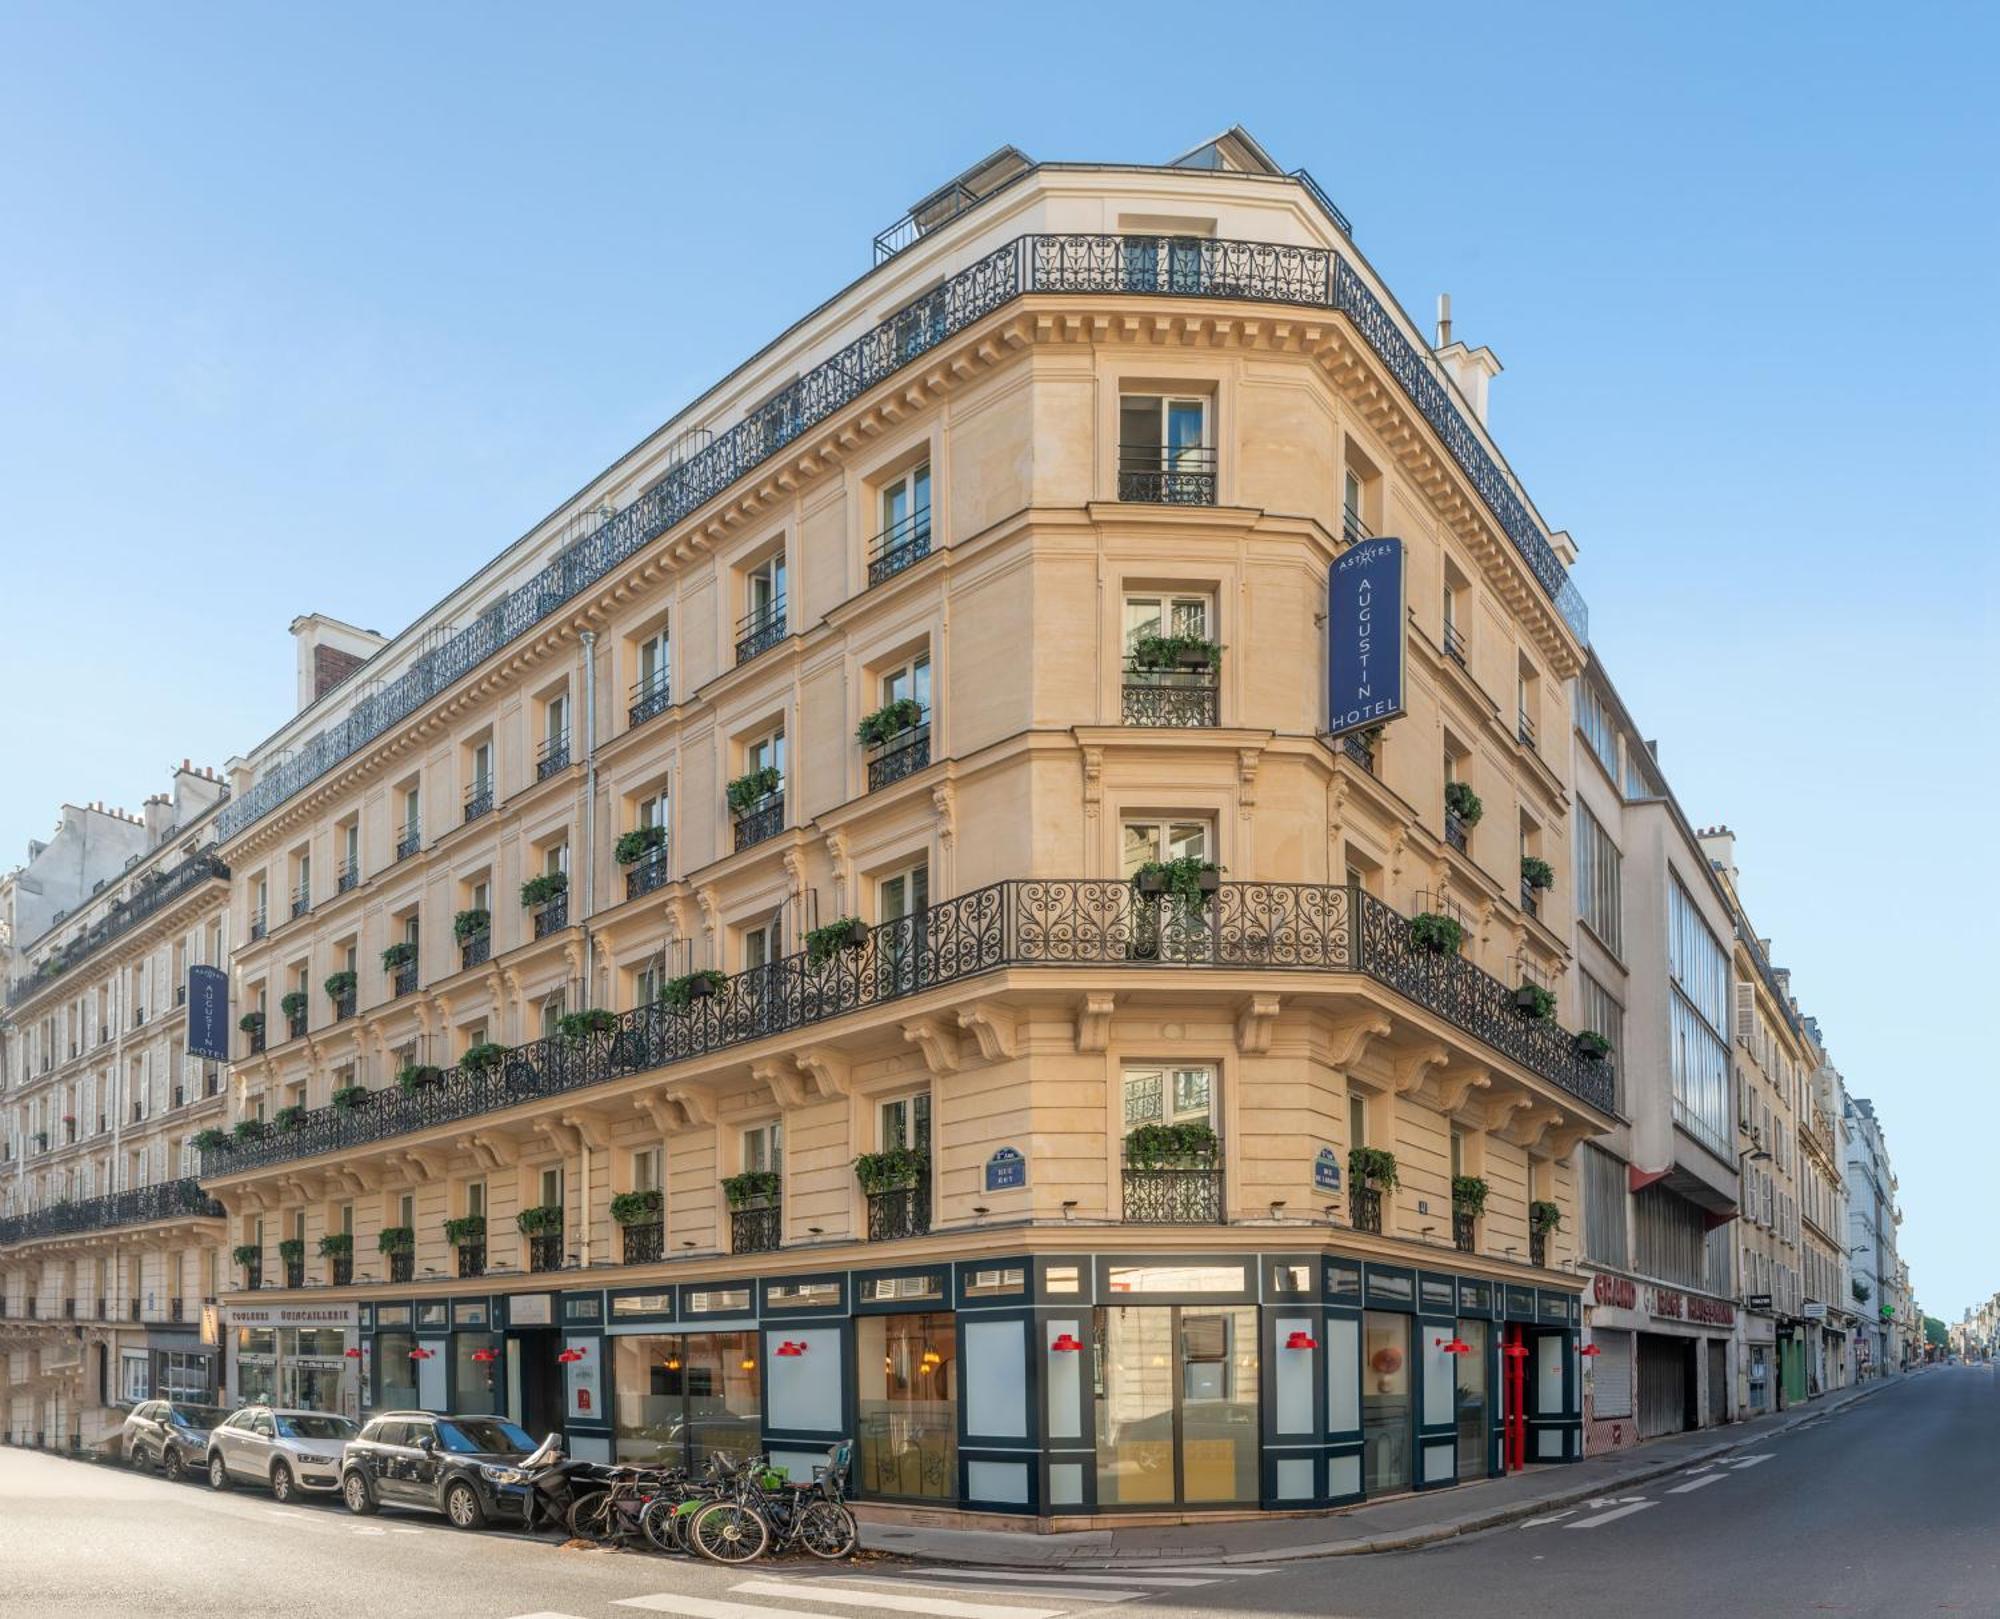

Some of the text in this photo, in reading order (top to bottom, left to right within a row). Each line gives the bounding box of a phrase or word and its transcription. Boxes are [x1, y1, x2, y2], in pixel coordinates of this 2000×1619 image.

[1339, 545, 1392, 571] ASTOTEL
[1358, 578, 1371, 700] AUGUSTIN
[1332, 698, 1397, 730] HOTEL
[204, 985, 213, 1047] AUGUSTIN
[190, 1046, 226, 1060] HOTEL
[1593, 1273, 1637, 1310] GRAND
[1643, 1286, 1683, 1318] GARAGE
[232, 1309, 349, 1321] COULEURS QUINCAILLERIE
